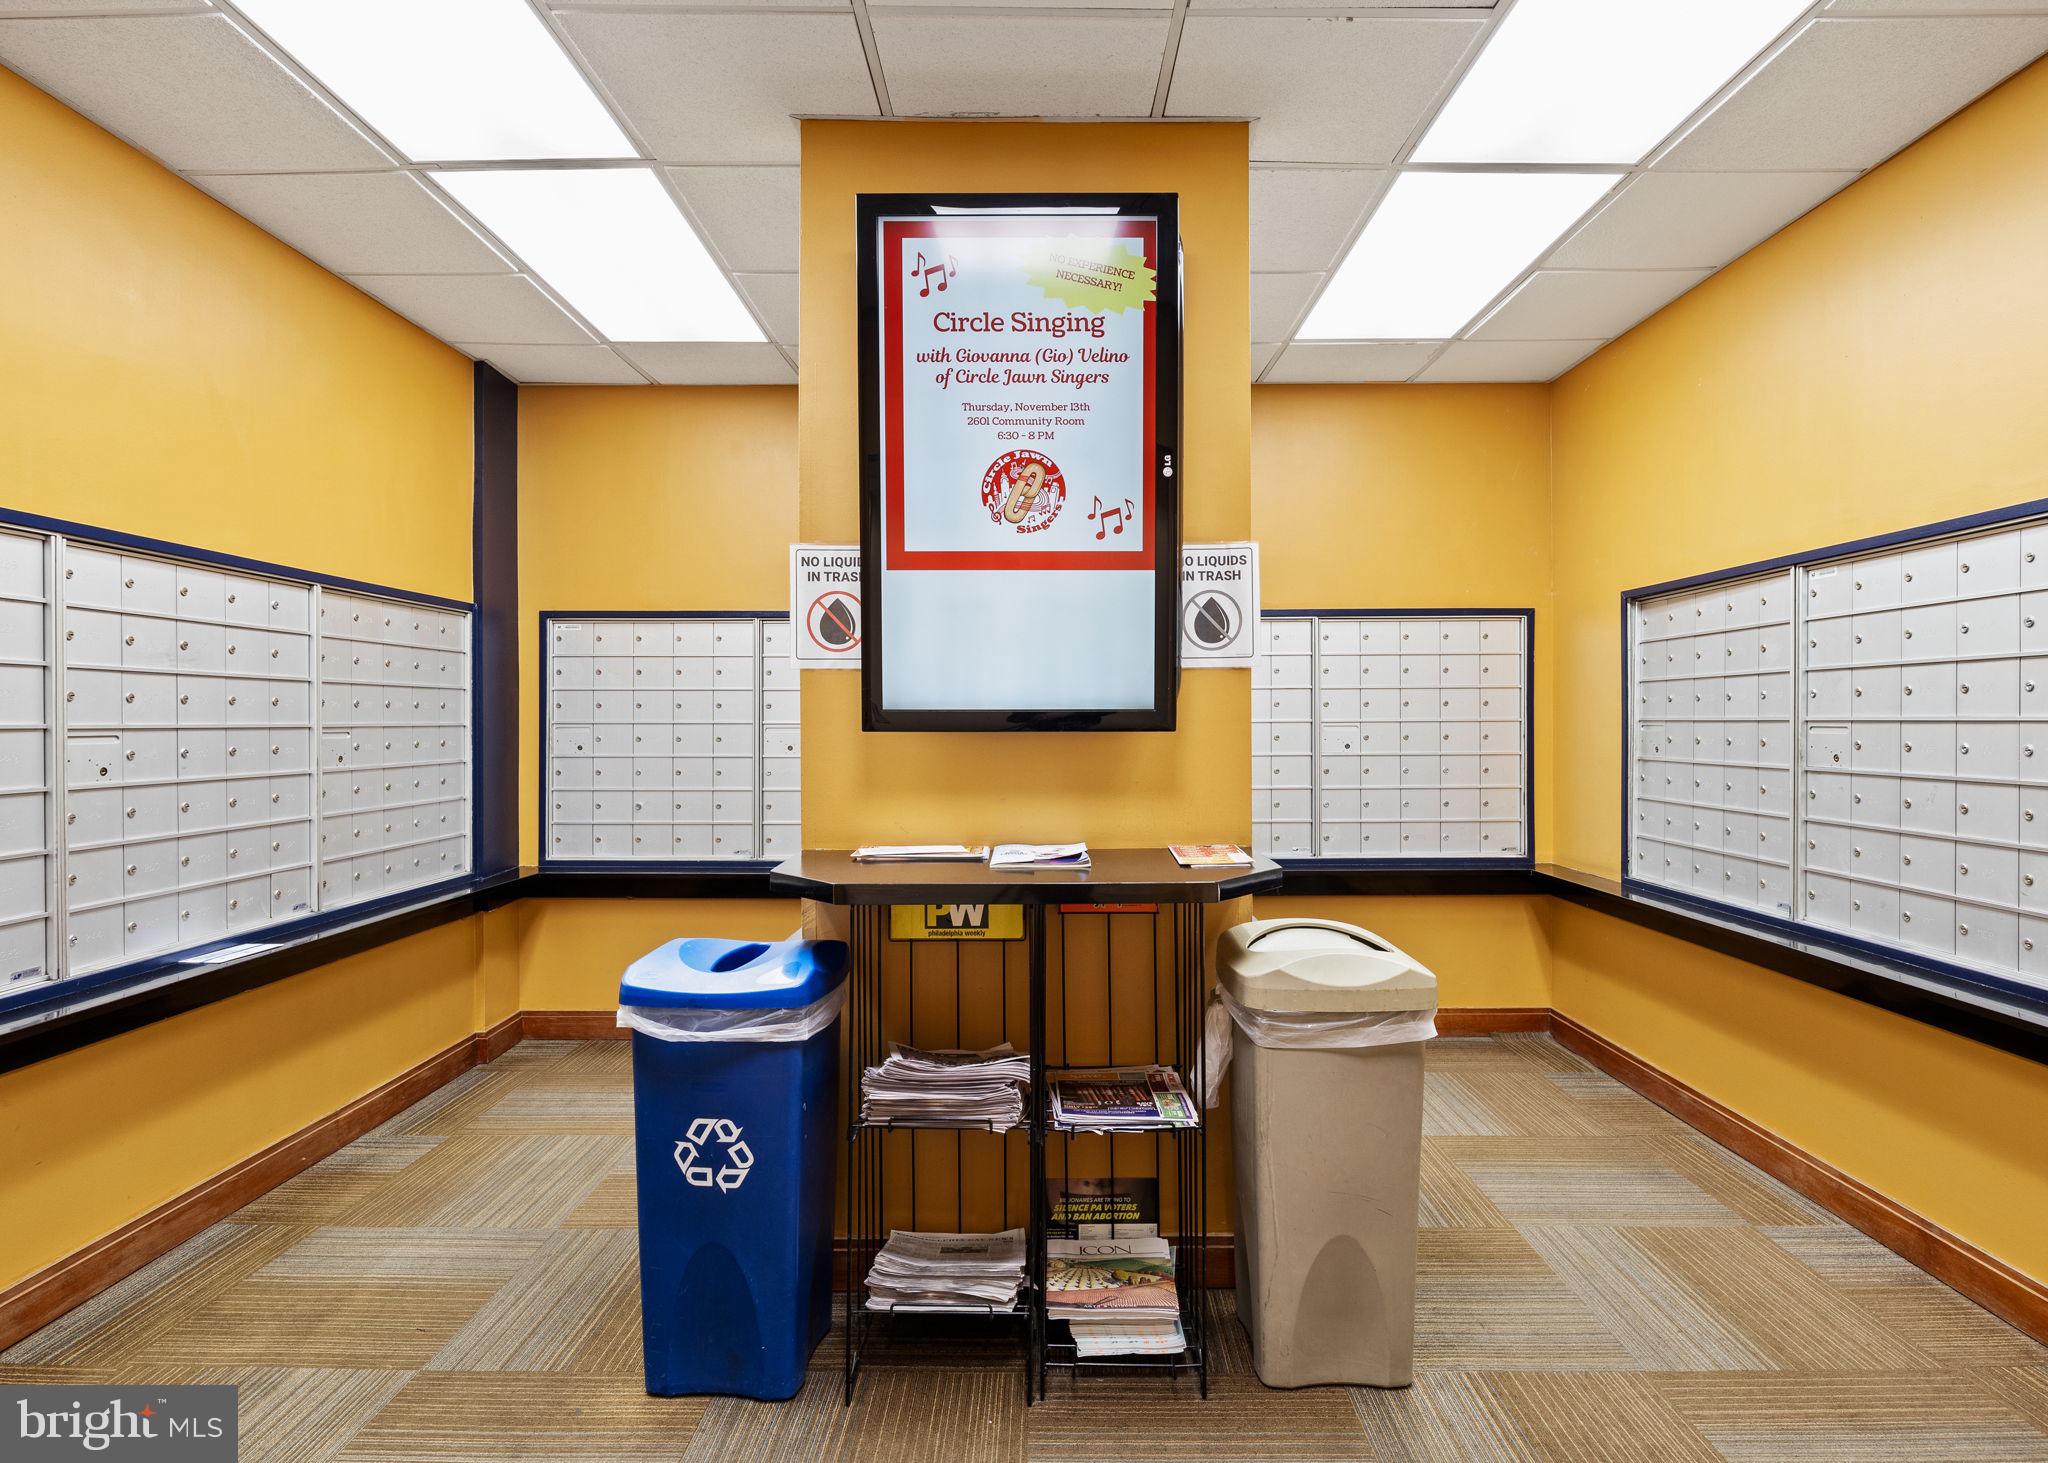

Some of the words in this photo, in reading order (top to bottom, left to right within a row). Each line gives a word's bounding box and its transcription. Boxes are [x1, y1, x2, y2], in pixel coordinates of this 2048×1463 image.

[1049, 252, 1066, 264] NO
[1068, 256, 1136, 281] EXPERIENCE
[1055, 268, 1123, 292] NECESSARY!
[933, 311, 1005, 333] Circle
[1011, 311, 1106, 338] Singing
[916, 347, 951, 364] with
[955, 348, 1031, 364] Giovanna
[1034, 347, 1075, 366] (Gio)
[1077, 347, 1130, 364] Velino
[935, 368, 954, 390] of
[956, 368, 1000, 385] Circle
[1003, 368, 1047, 386] Jawn
[1050, 368, 1110, 390] Singers
[961, 402, 1013, 413] Thursday,
[1014, 402, 1069, 412] November
[1070, 402, 1090, 412] 13th
[967, 416, 990, 426] 2601
[992, 416, 1053, 428] Community
[1055, 416, 1085, 426] Room
[997, 431, 1020, 441] 6:30
[1027, 431, 1036, 441] 8
[1036, 431, 1055, 441] PM
[1164, 454, 1172, 466] LG
[982, 454, 1011, 495] Circle
[1012, 449, 1054, 468] Jawn
[1015, 503, 1063, 534] Singers
[801, 556, 820, 567] NO
[1197, 555, 1247, 568] LIQUIDS
[807, 571, 821, 582] IN
[823, 571, 861, 582] TRAS
[1198, 570, 1241, 581] TRASH
[927, 929, 964, 939] philadelphia
[964, 929, 986, 939] weekly
[1090, 1203, 1102, 1212] PA
[1079, 1244, 1132, 1256] ICON
